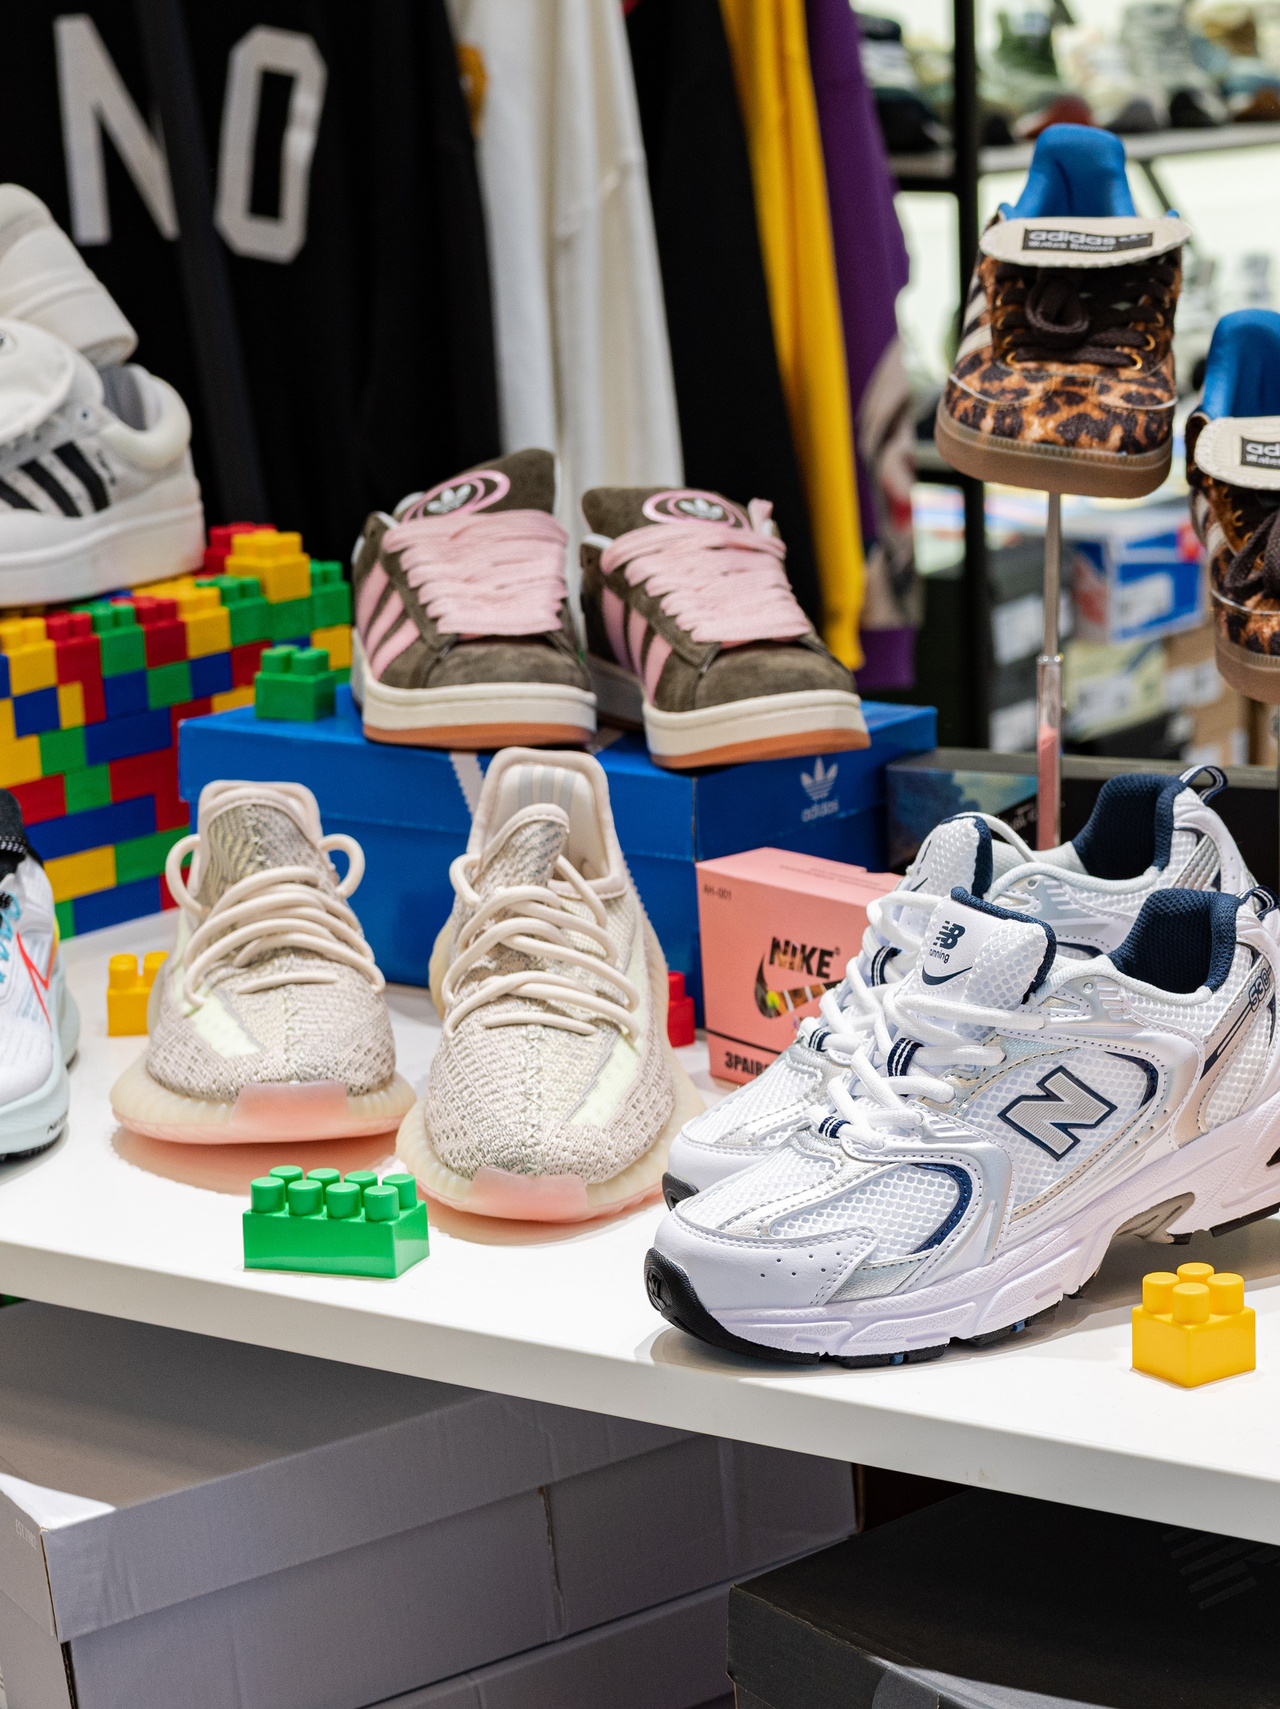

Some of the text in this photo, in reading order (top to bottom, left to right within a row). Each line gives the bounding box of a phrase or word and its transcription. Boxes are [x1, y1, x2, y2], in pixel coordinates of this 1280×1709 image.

[1028, 230, 1118, 246] adidas
[768, 936, 835, 980] NIKE
[724, 1051, 771, 1077] 3PAIR
[997, 1064, 1119, 1162] N
